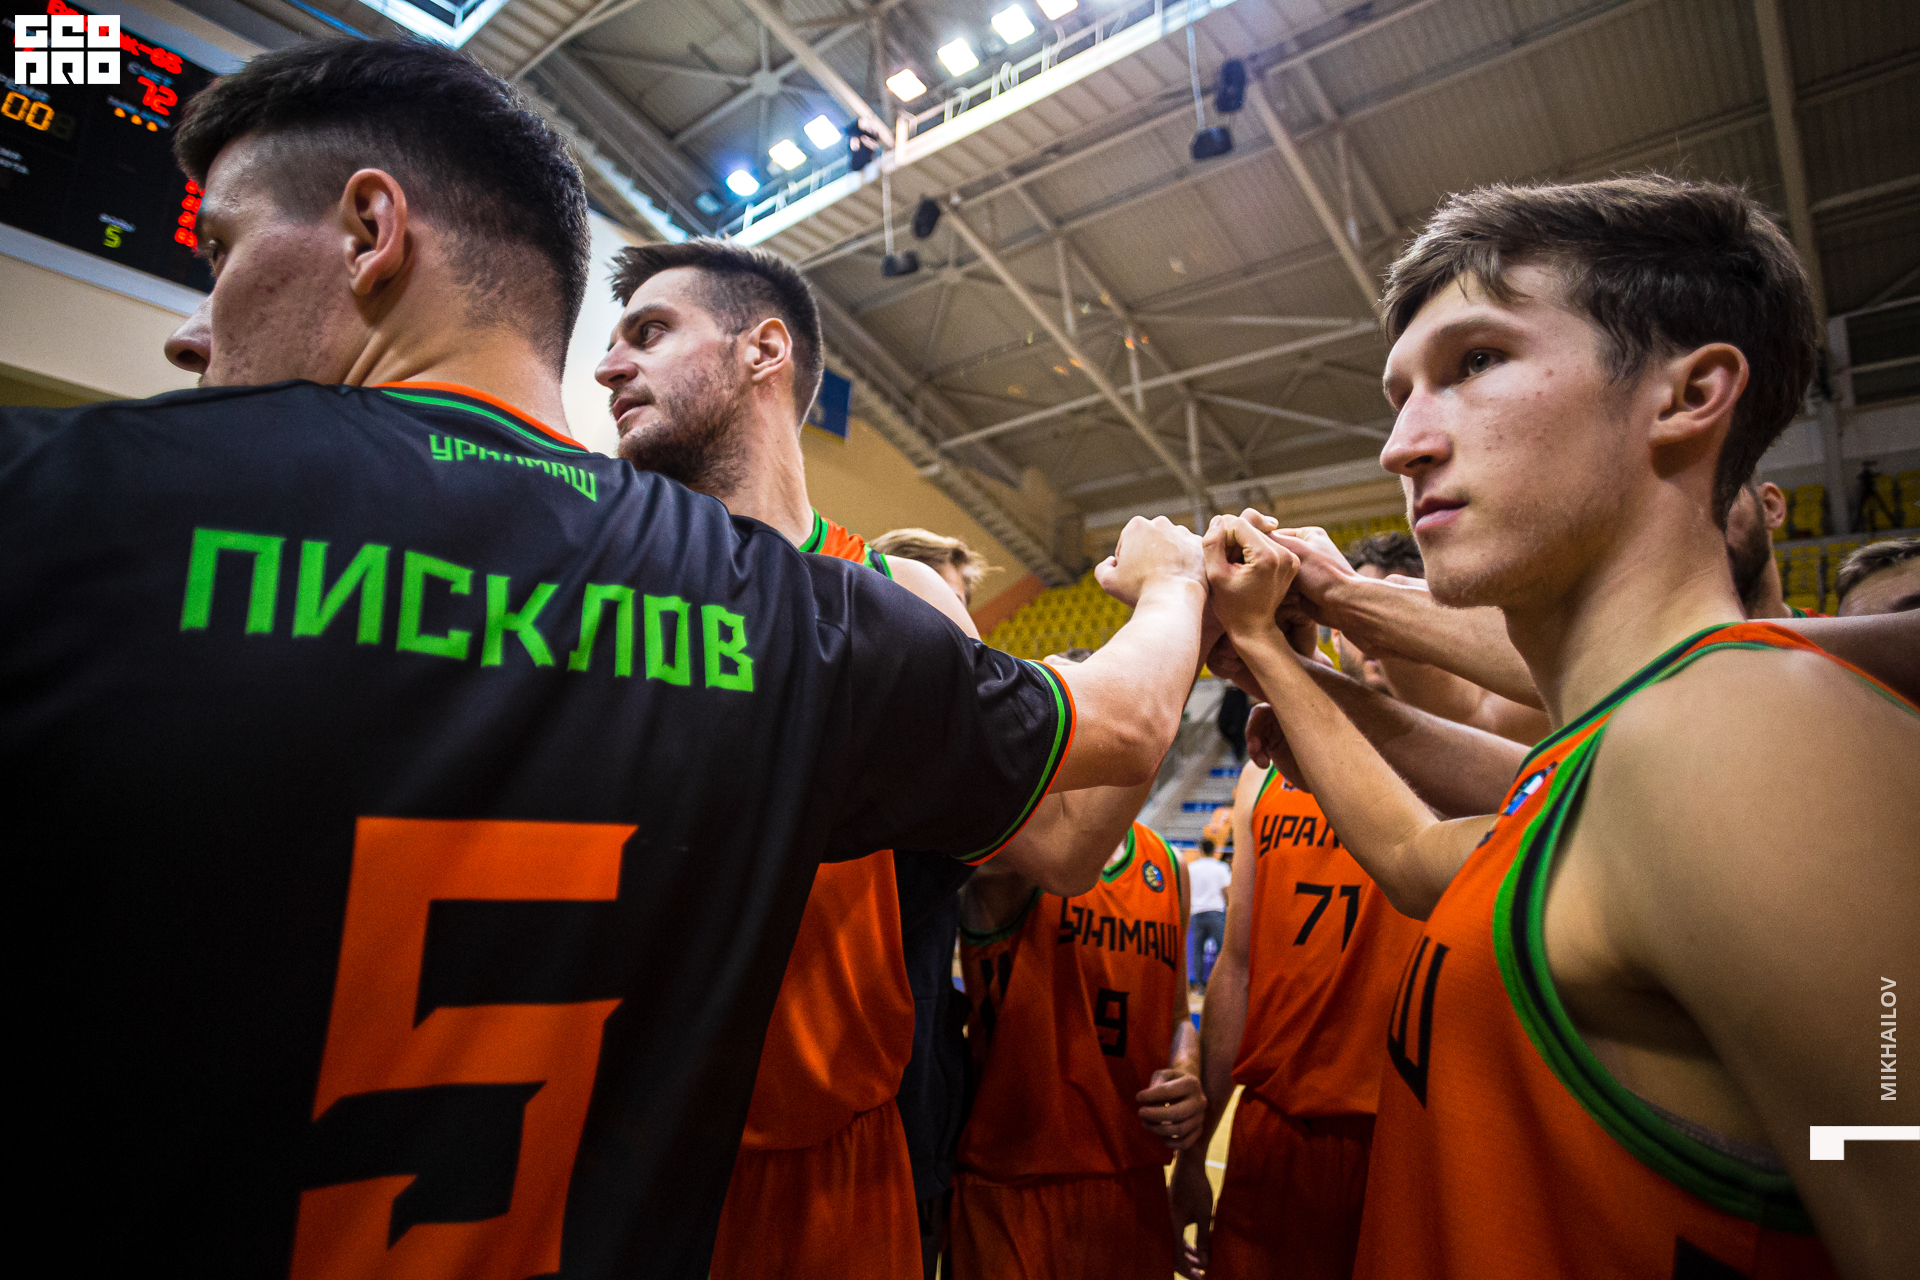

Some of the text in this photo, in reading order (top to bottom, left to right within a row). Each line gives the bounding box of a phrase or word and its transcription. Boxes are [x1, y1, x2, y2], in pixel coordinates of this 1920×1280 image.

[1, 91, 55, 131] 00
[137, 76, 178, 115] 72
[429, 434, 597, 502] УРМАШ
[180, 527, 754, 692] ПИСКЛОВ
[1293, 881, 1362, 953] 71
[290, 816, 640, 1280] 5
[1095, 988, 1131, 1058] 9
